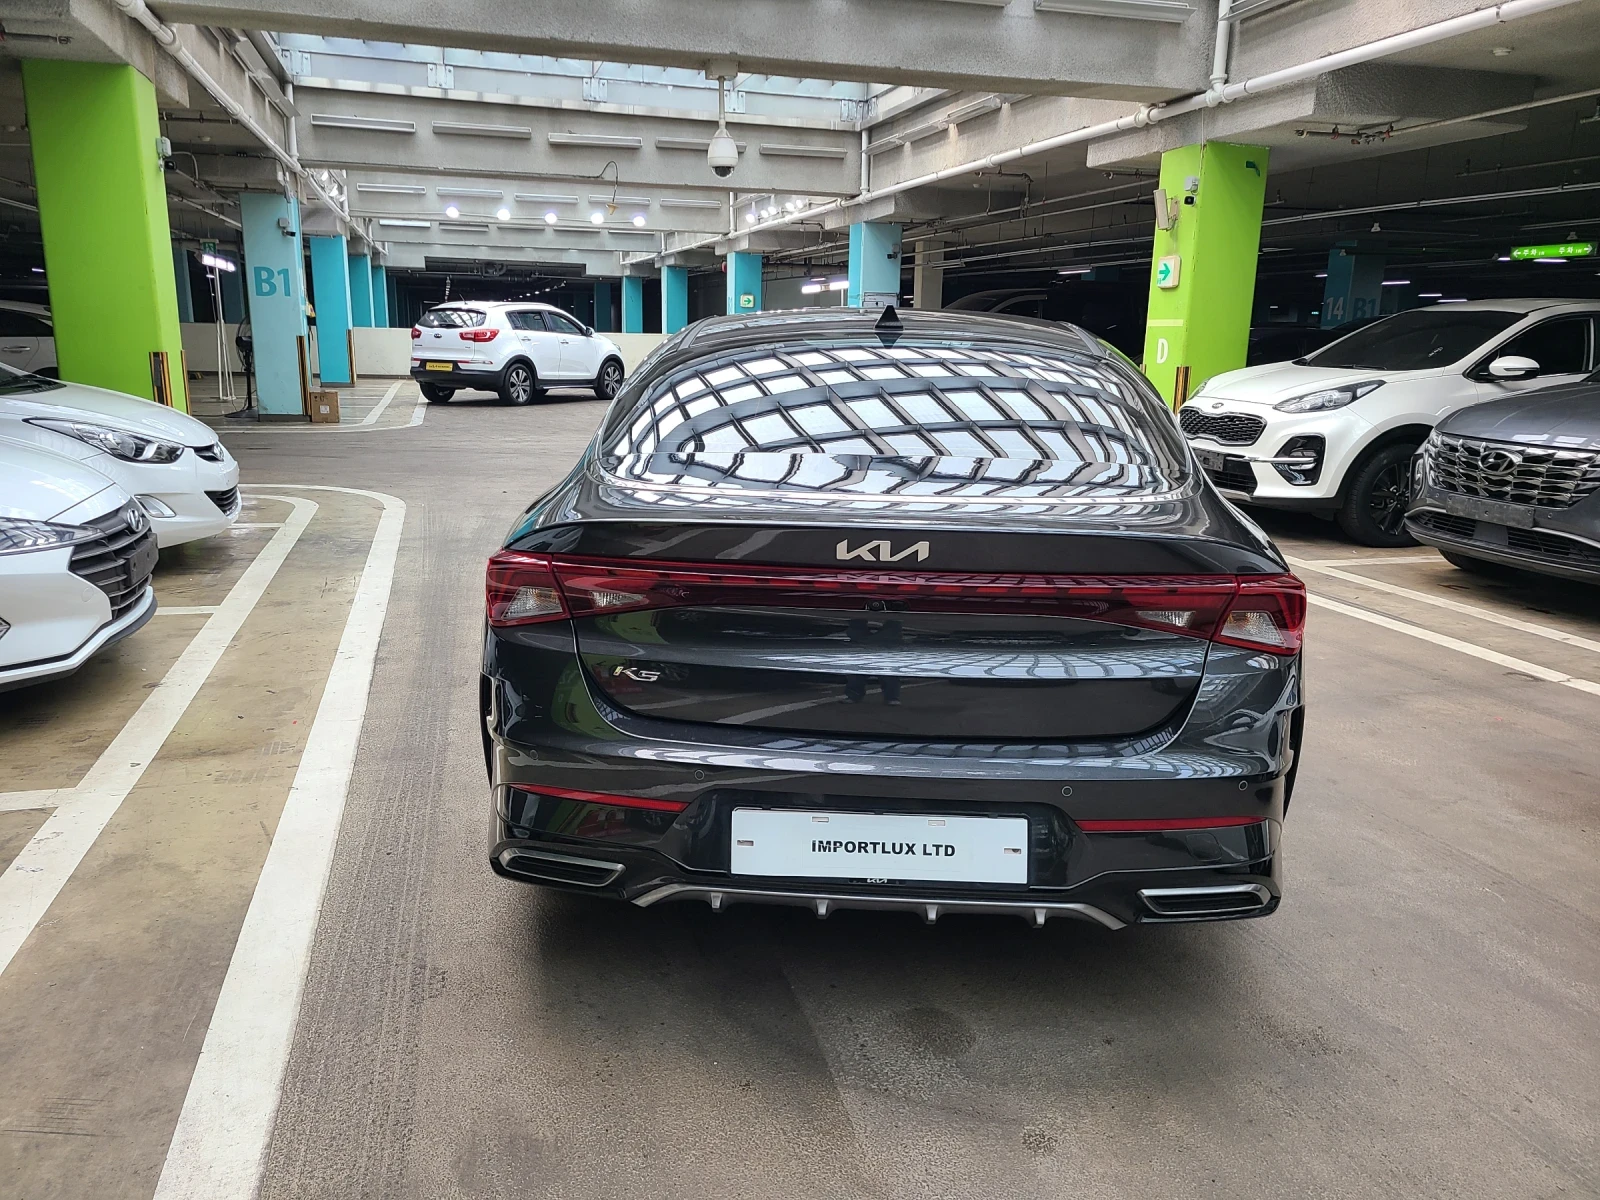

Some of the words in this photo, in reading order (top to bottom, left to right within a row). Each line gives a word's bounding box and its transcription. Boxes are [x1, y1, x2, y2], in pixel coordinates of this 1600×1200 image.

[253, 266, 291, 297] B1
[1326, 296, 1344, 320] 14
[1352, 297, 1377, 320] B1
[1156, 338, 1169, 364] D
[836, 539, 930, 562] KIA
[613, 666, 661, 681] K5
[811, 840, 917, 855] IMPORTLUX
[922, 843, 956, 857] LTD
